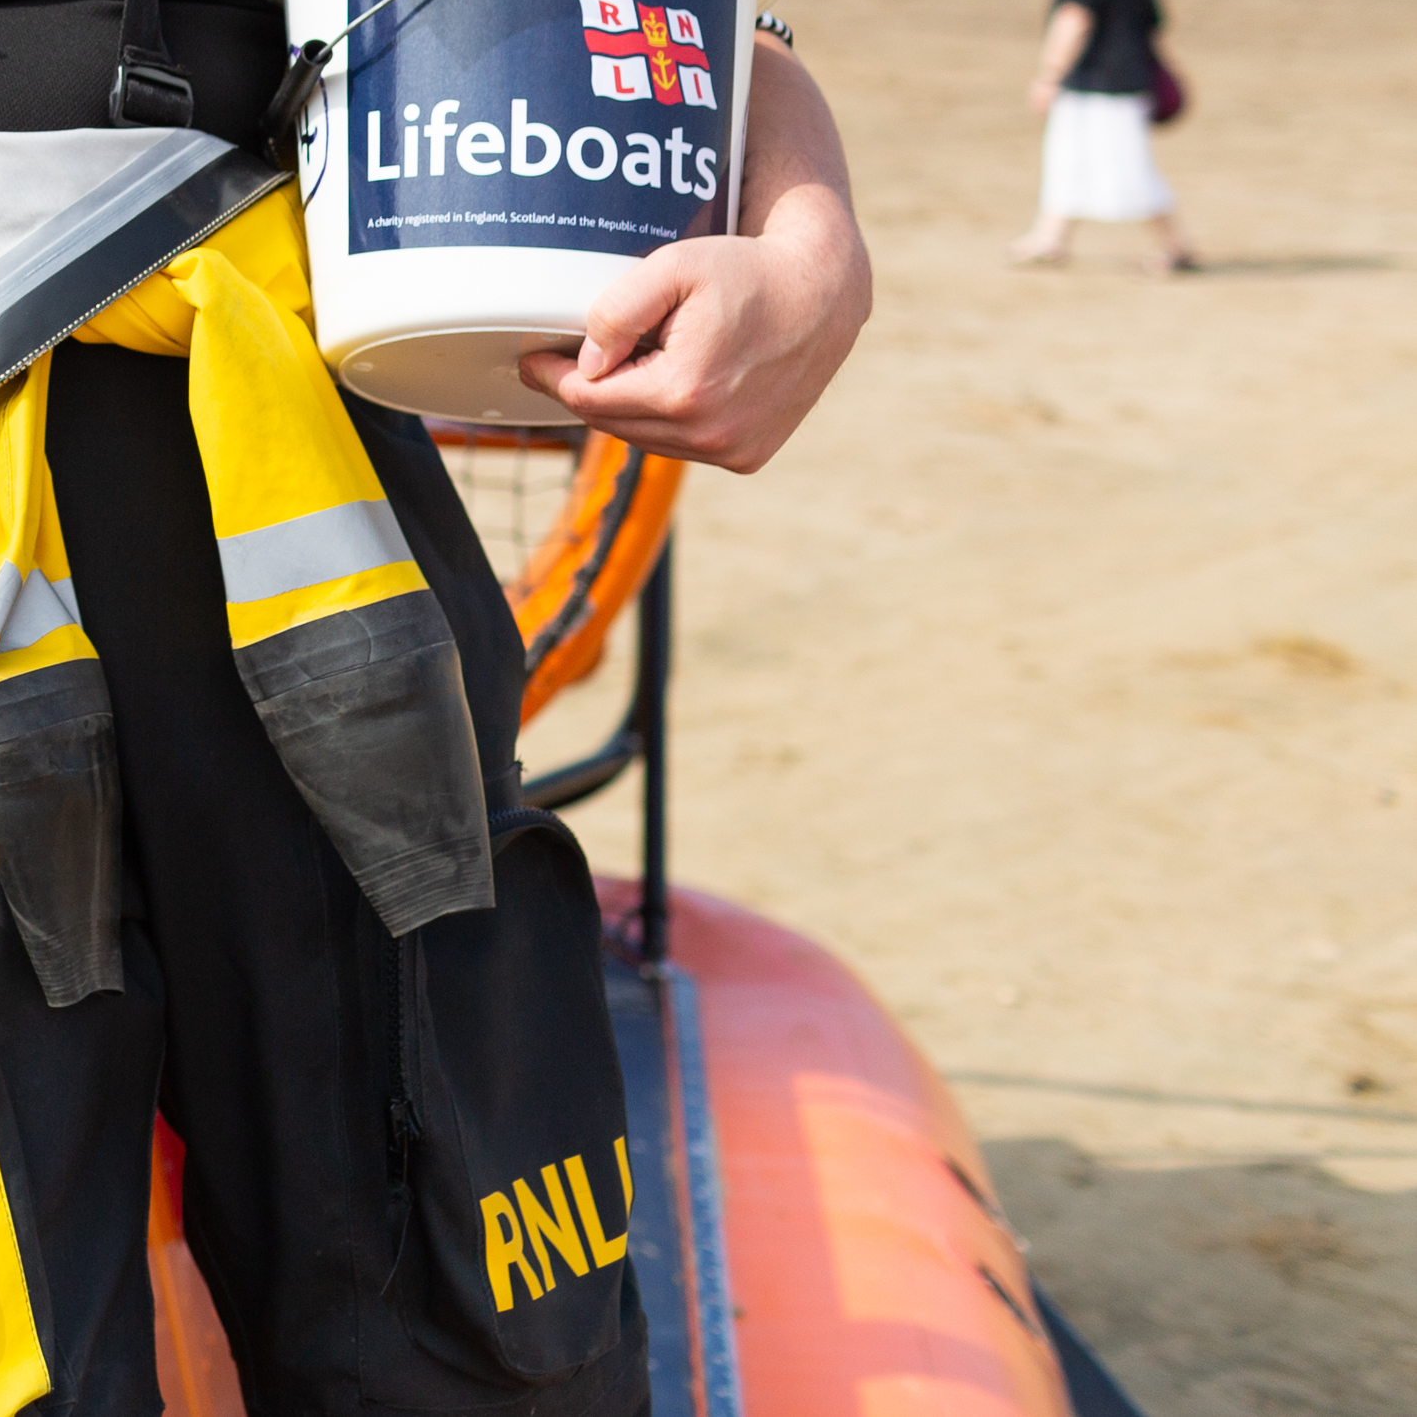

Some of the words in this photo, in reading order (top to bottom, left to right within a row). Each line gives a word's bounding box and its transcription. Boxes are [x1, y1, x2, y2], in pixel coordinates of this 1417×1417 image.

[598, 0, 623, 27] R
[677, 14, 695, 39] N
[613, 65, 636, 94] L
[693, 73, 703, 100] I
[366, 98, 718, 202] Lifeboats
[367, 218, 375, 229] A
[375, 215, 403, 228] charity
[405, 211, 451, 227] registered
[453, 211, 463, 222] in
[465, 210, 508, 225] England,
[510, 212, 555, 225] Scotland
[557, 215, 577, 226] and
[579, 215, 596, 228] the
[598, 217, 638, 232] Republic
[639, 223, 649, 234] of
[650, 225, 678, 240] Ireland
